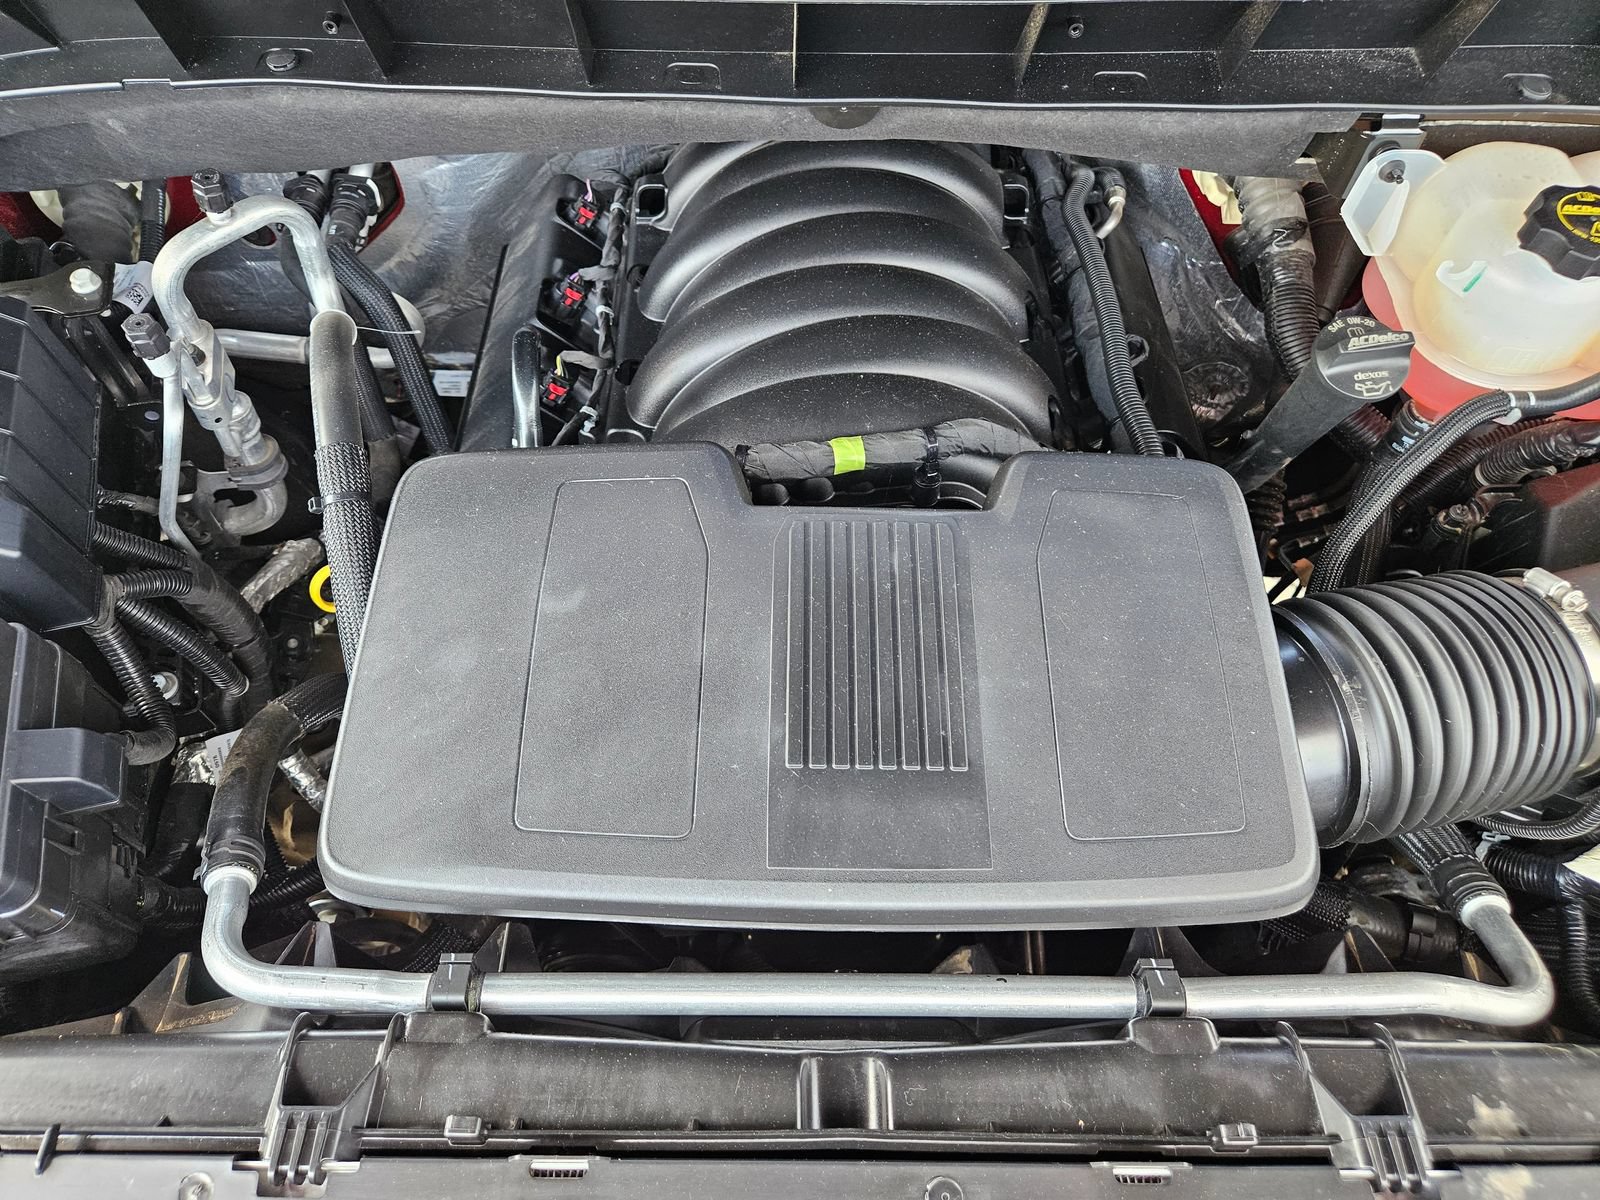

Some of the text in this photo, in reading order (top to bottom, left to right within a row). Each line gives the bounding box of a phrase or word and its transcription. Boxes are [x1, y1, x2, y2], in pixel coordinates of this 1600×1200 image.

[1328, 318, 1375, 333] SAE 0W-20
[1348, 333, 1409, 349] ACDelco
[1354, 371, 1389, 381] dexos
